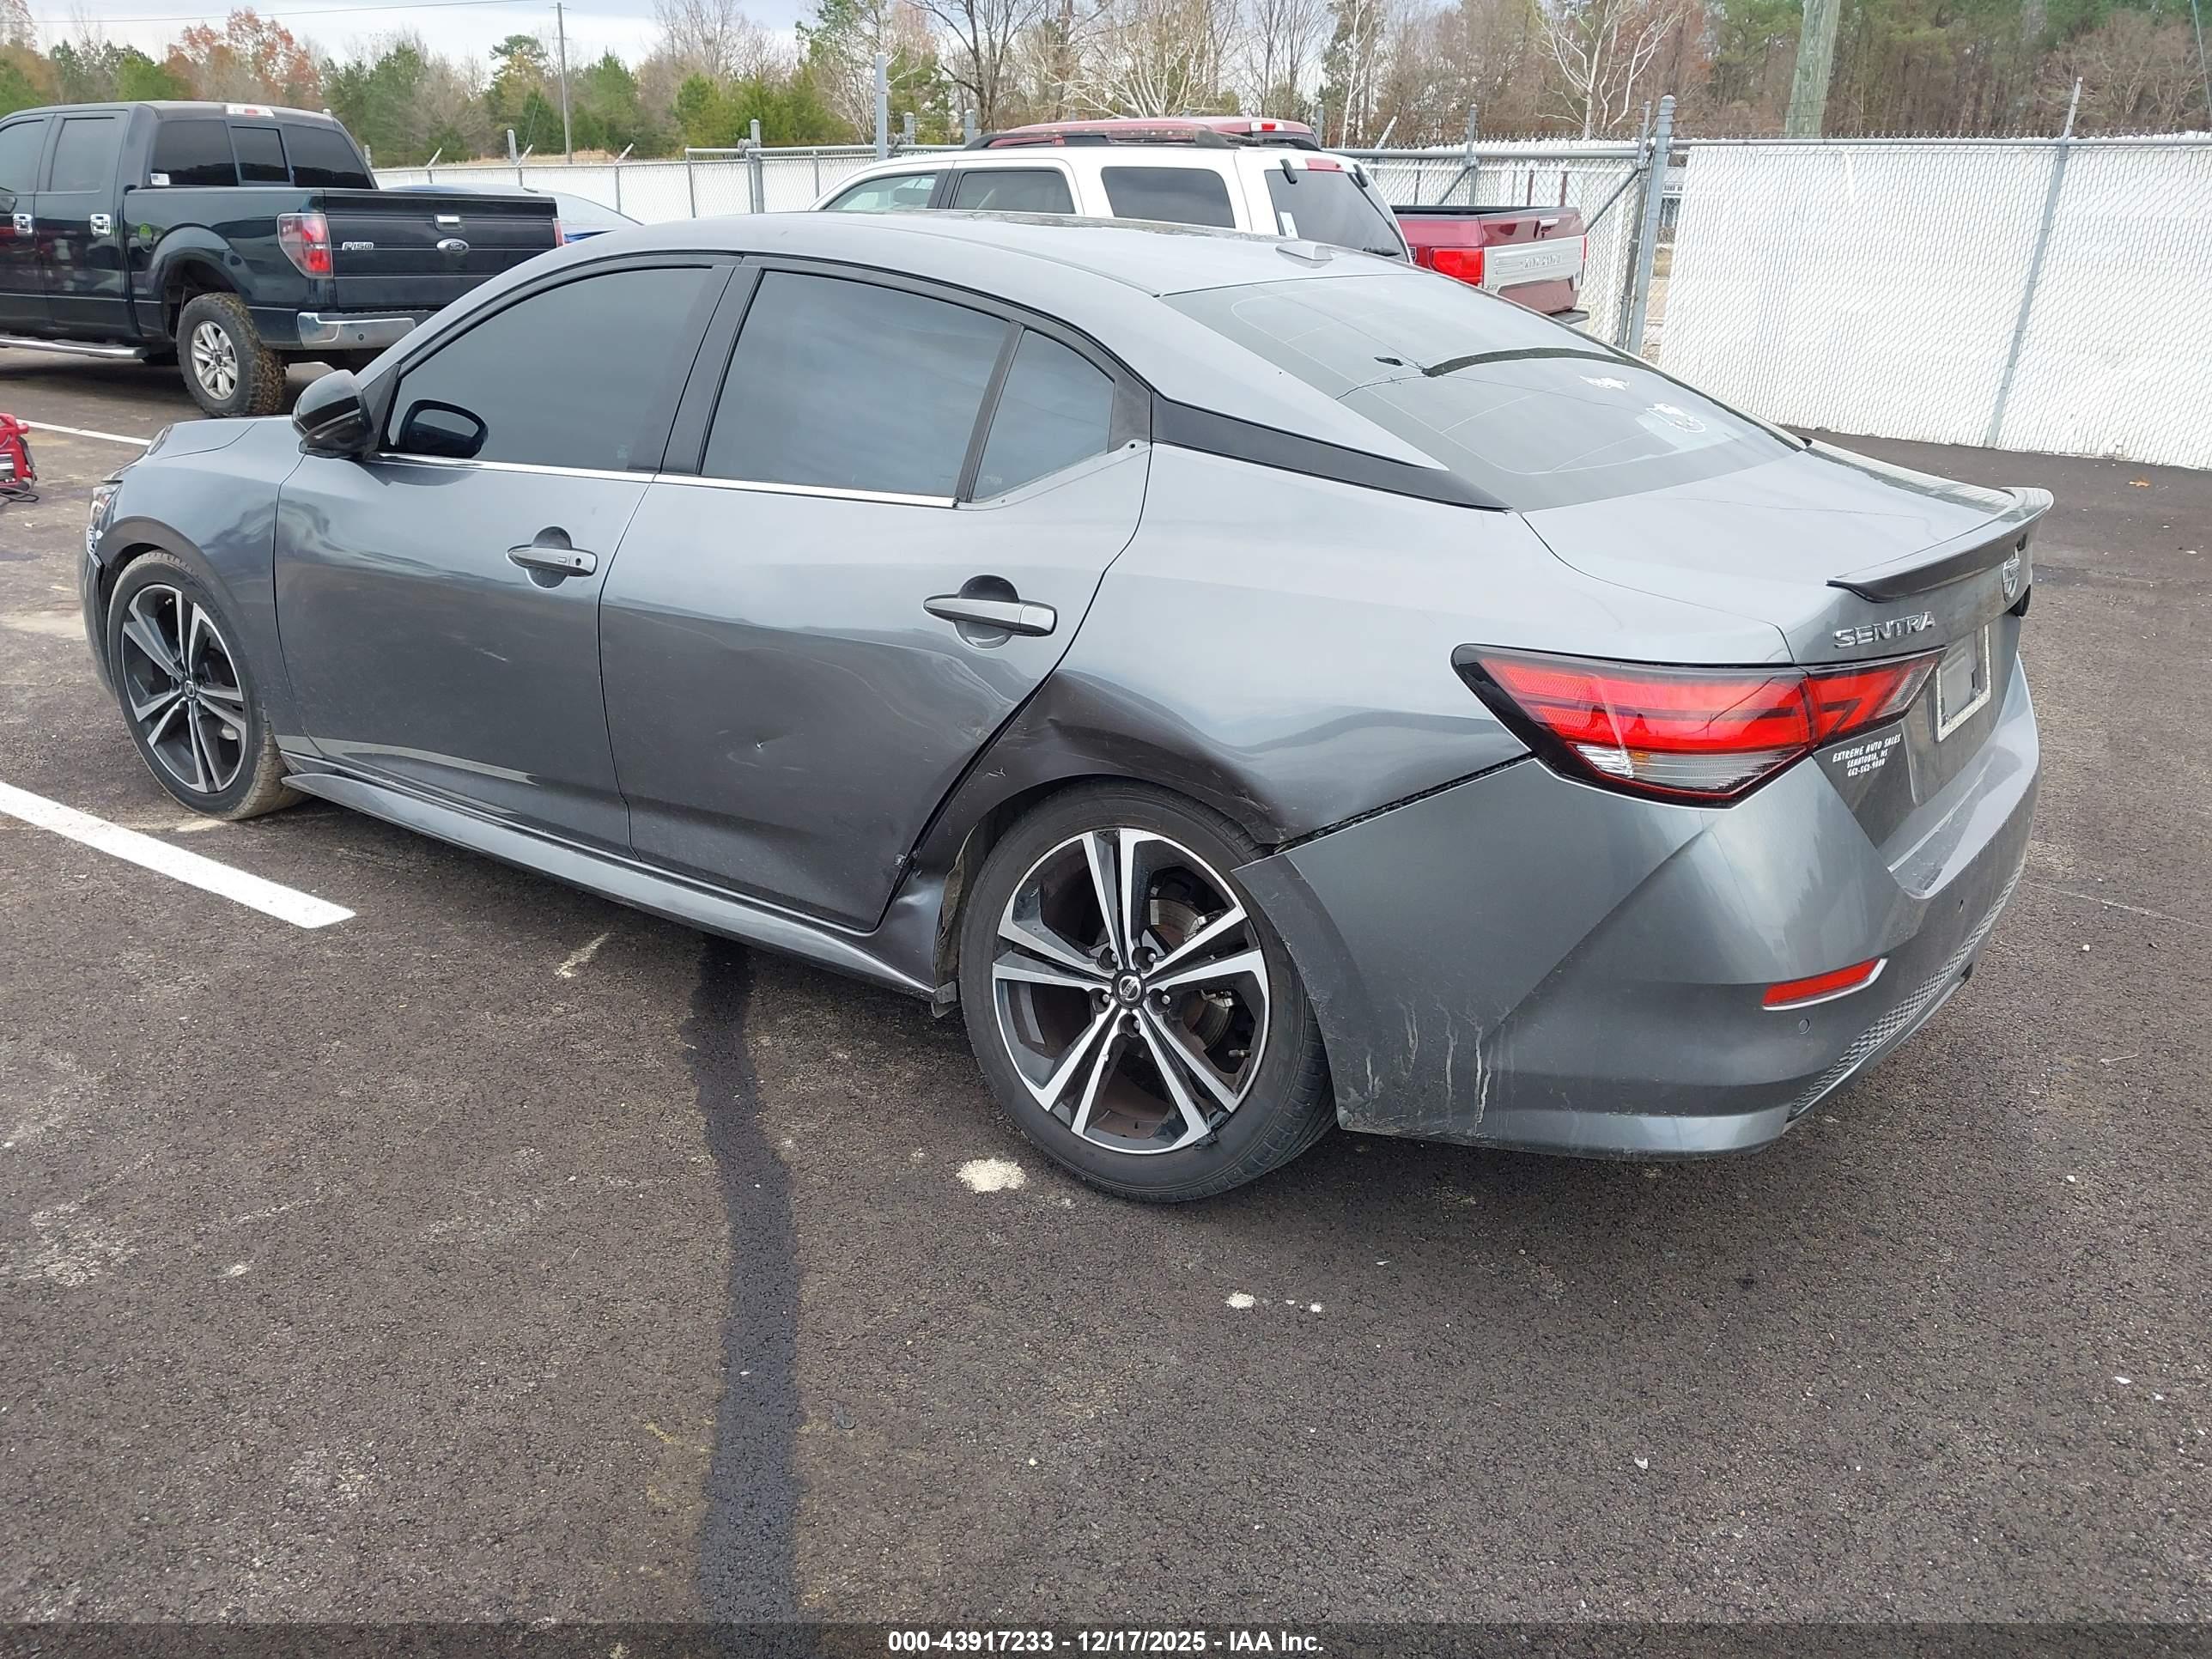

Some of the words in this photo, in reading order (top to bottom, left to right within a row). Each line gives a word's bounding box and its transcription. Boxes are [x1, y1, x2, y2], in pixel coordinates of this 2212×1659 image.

[1833, 611, 1936, 649] SENTRA
[1832, 745, 1864, 763] EXTREME
[1865, 740, 1882, 754] AUTO
[1884, 733, 1901, 748] SALES
